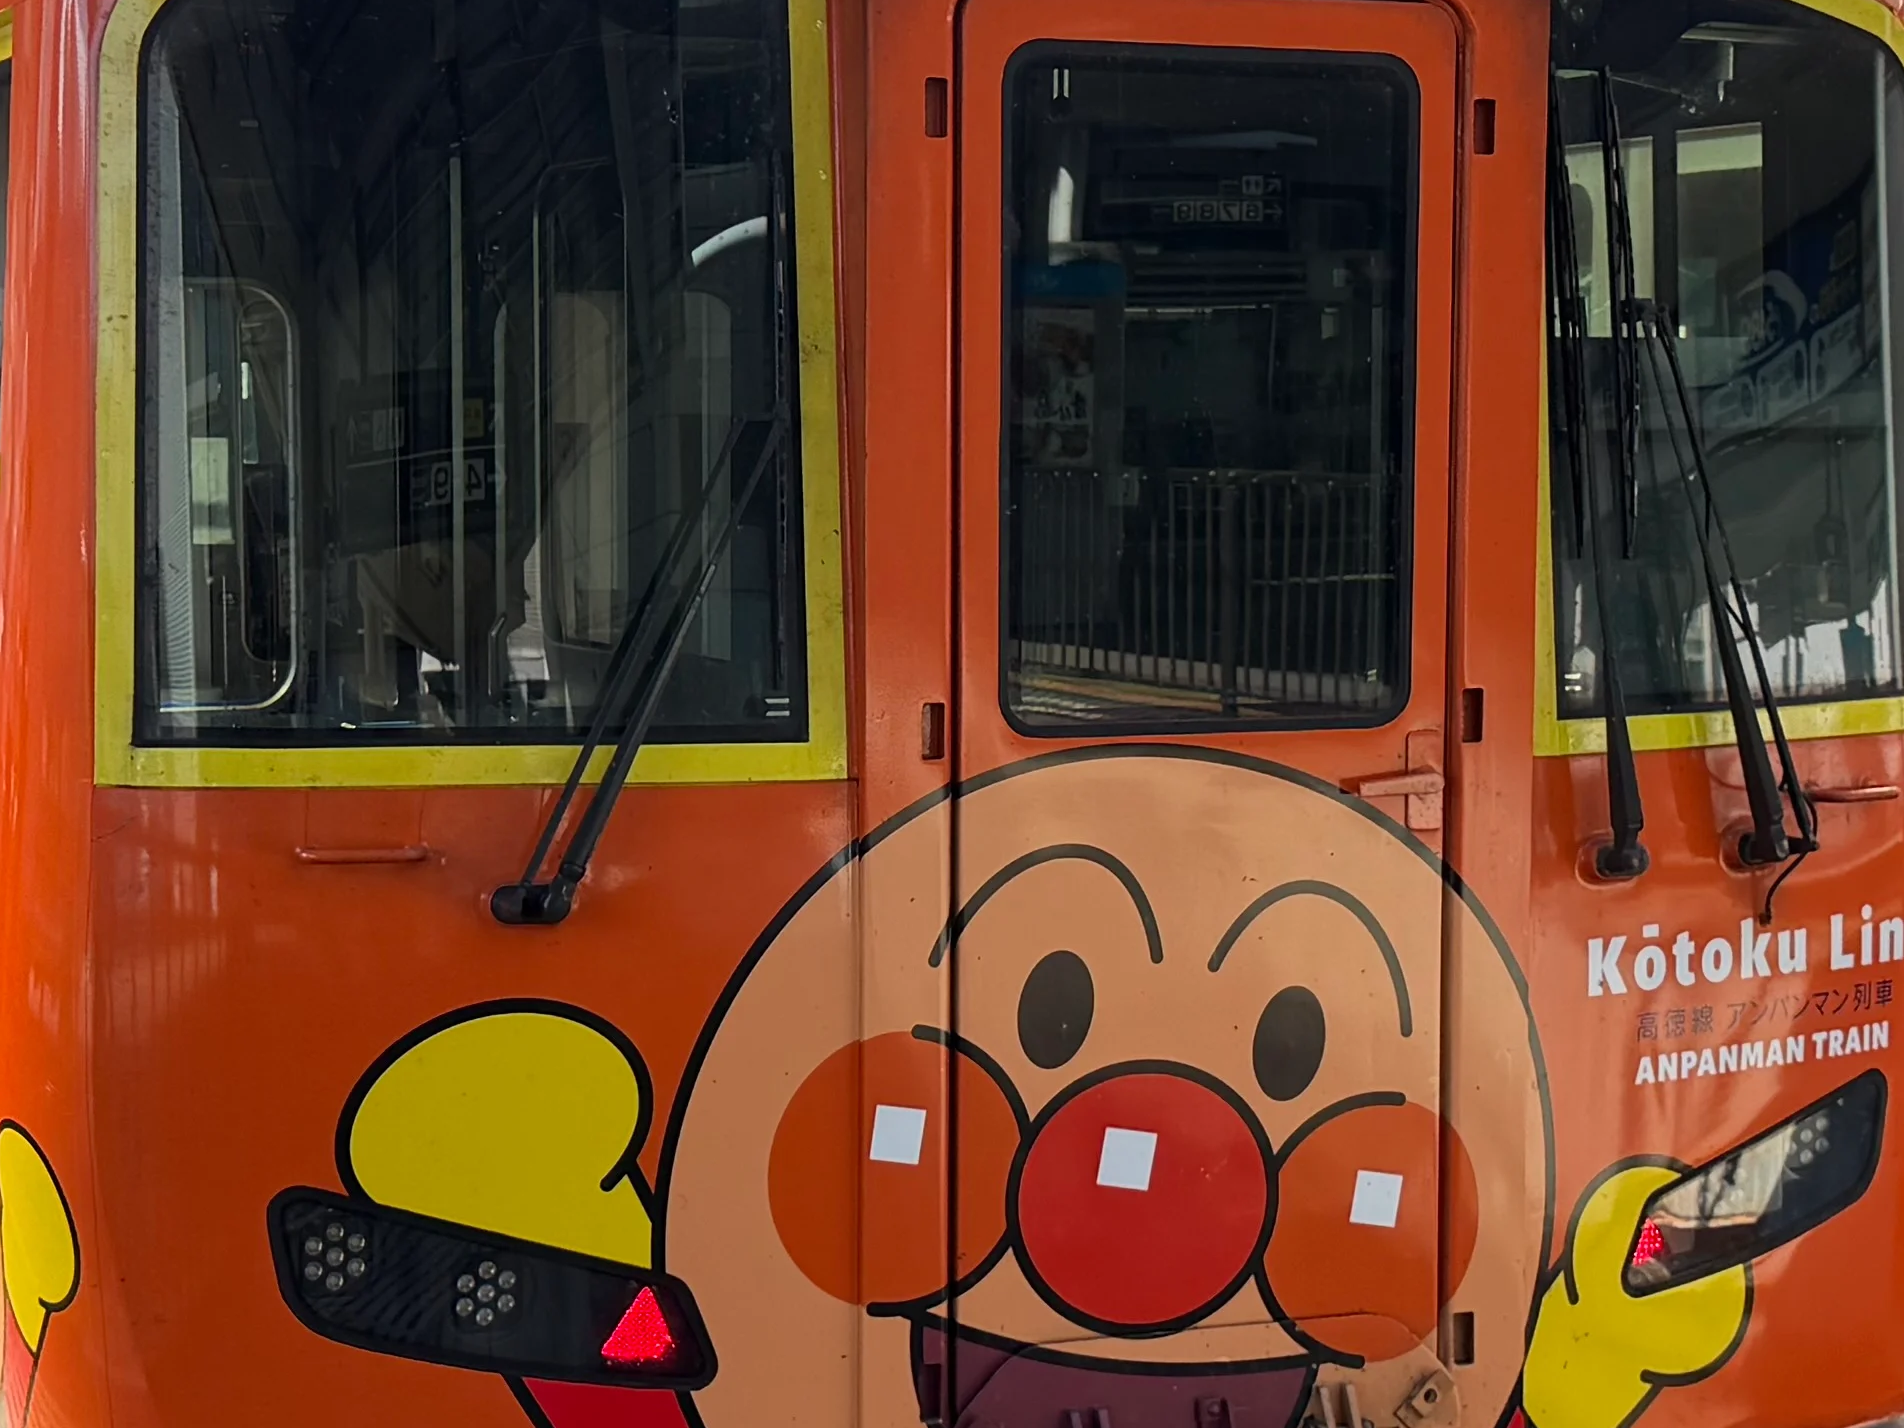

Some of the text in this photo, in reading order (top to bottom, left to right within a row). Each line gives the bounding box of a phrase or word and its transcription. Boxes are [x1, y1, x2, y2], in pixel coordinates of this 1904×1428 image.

[1587, 917, 1808, 997] Kōtoku
[1635, 1020, 1890, 1085] ANPANMAN TRAIN
[1636, 1003, 1714, 1043] 高徳線
